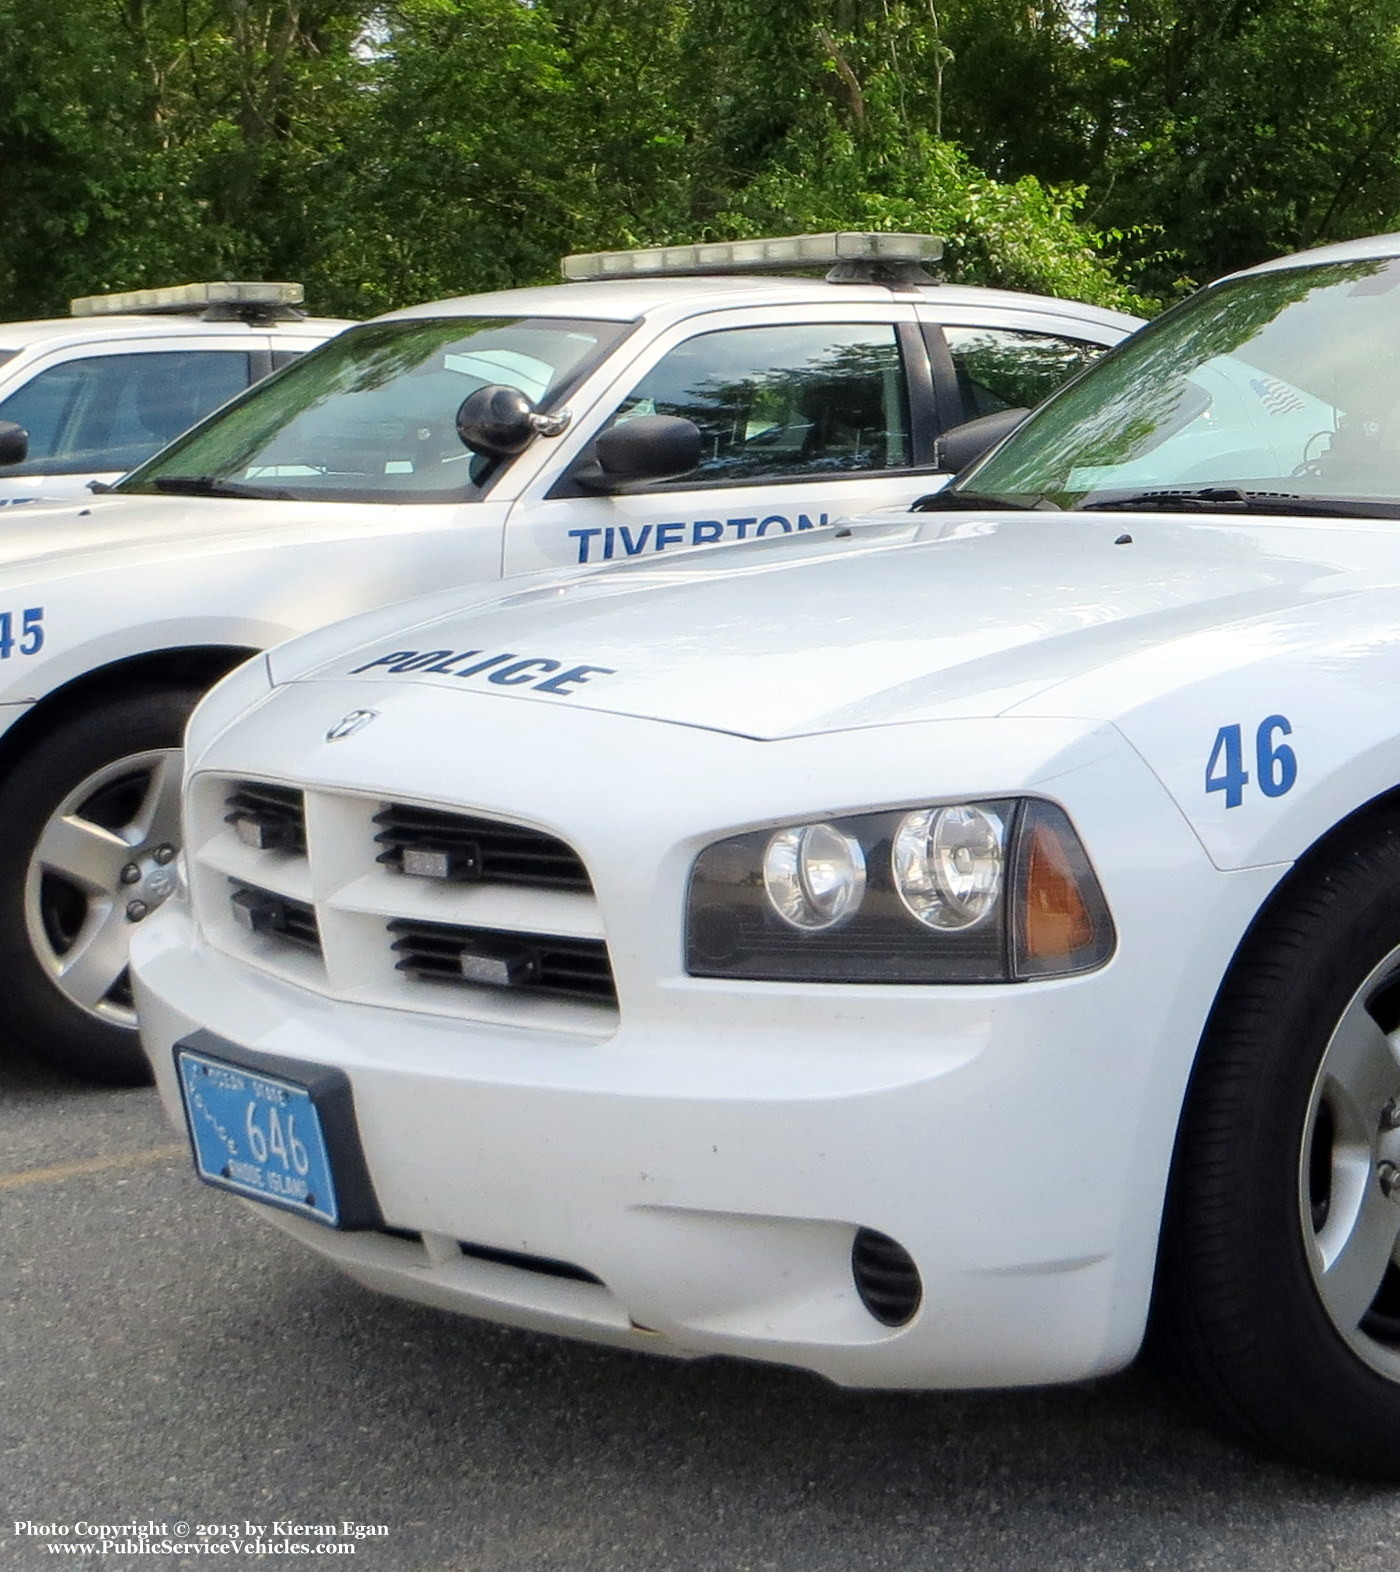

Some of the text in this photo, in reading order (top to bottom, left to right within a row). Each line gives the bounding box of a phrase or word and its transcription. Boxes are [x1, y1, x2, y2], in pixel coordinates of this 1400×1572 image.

[347, 649, 618, 696] POLICE
[1205, 714, 1298, 810] 46
[246, 1101, 308, 1175] 646
